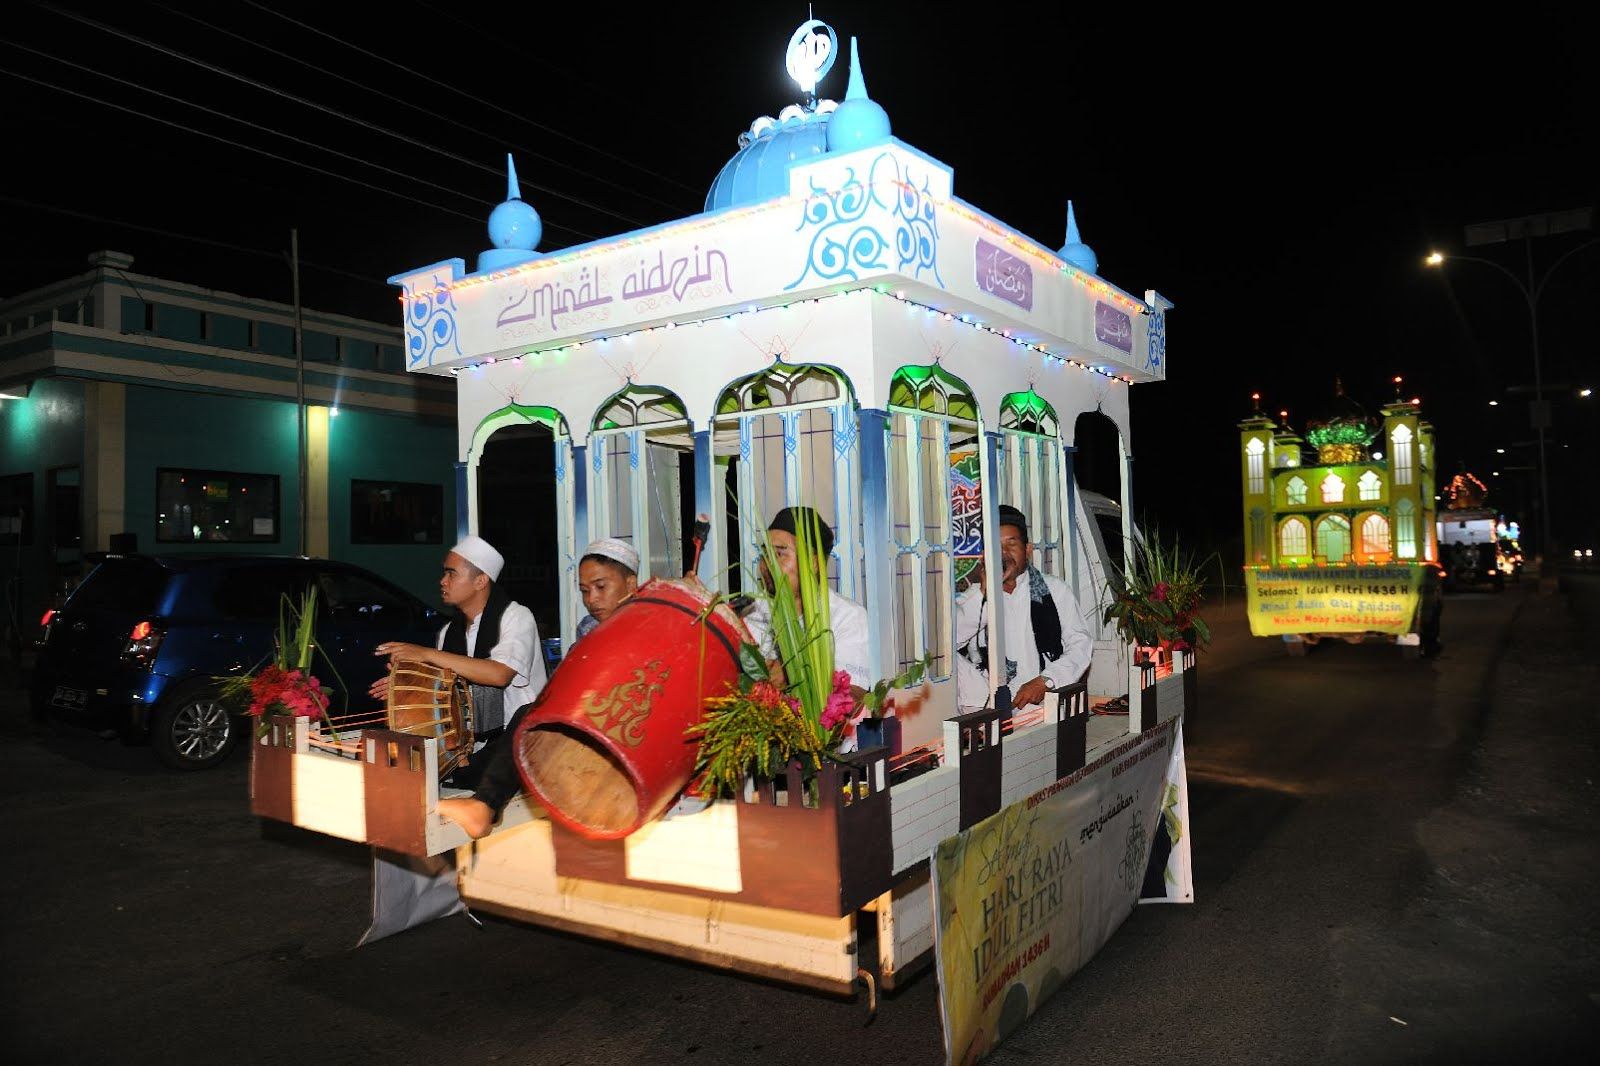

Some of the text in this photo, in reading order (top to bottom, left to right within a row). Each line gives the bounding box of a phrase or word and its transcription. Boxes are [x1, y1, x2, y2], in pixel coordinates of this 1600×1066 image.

[1257, 584, 1409, 597] Selamat Idul Fitri 1436 H
[973, 917, 1011, 983] IDUL
[1019, 875, 1064, 932] FITRI
[981, 867, 1023, 933] HARI
[1032, 839, 1073, 890] RAYA
